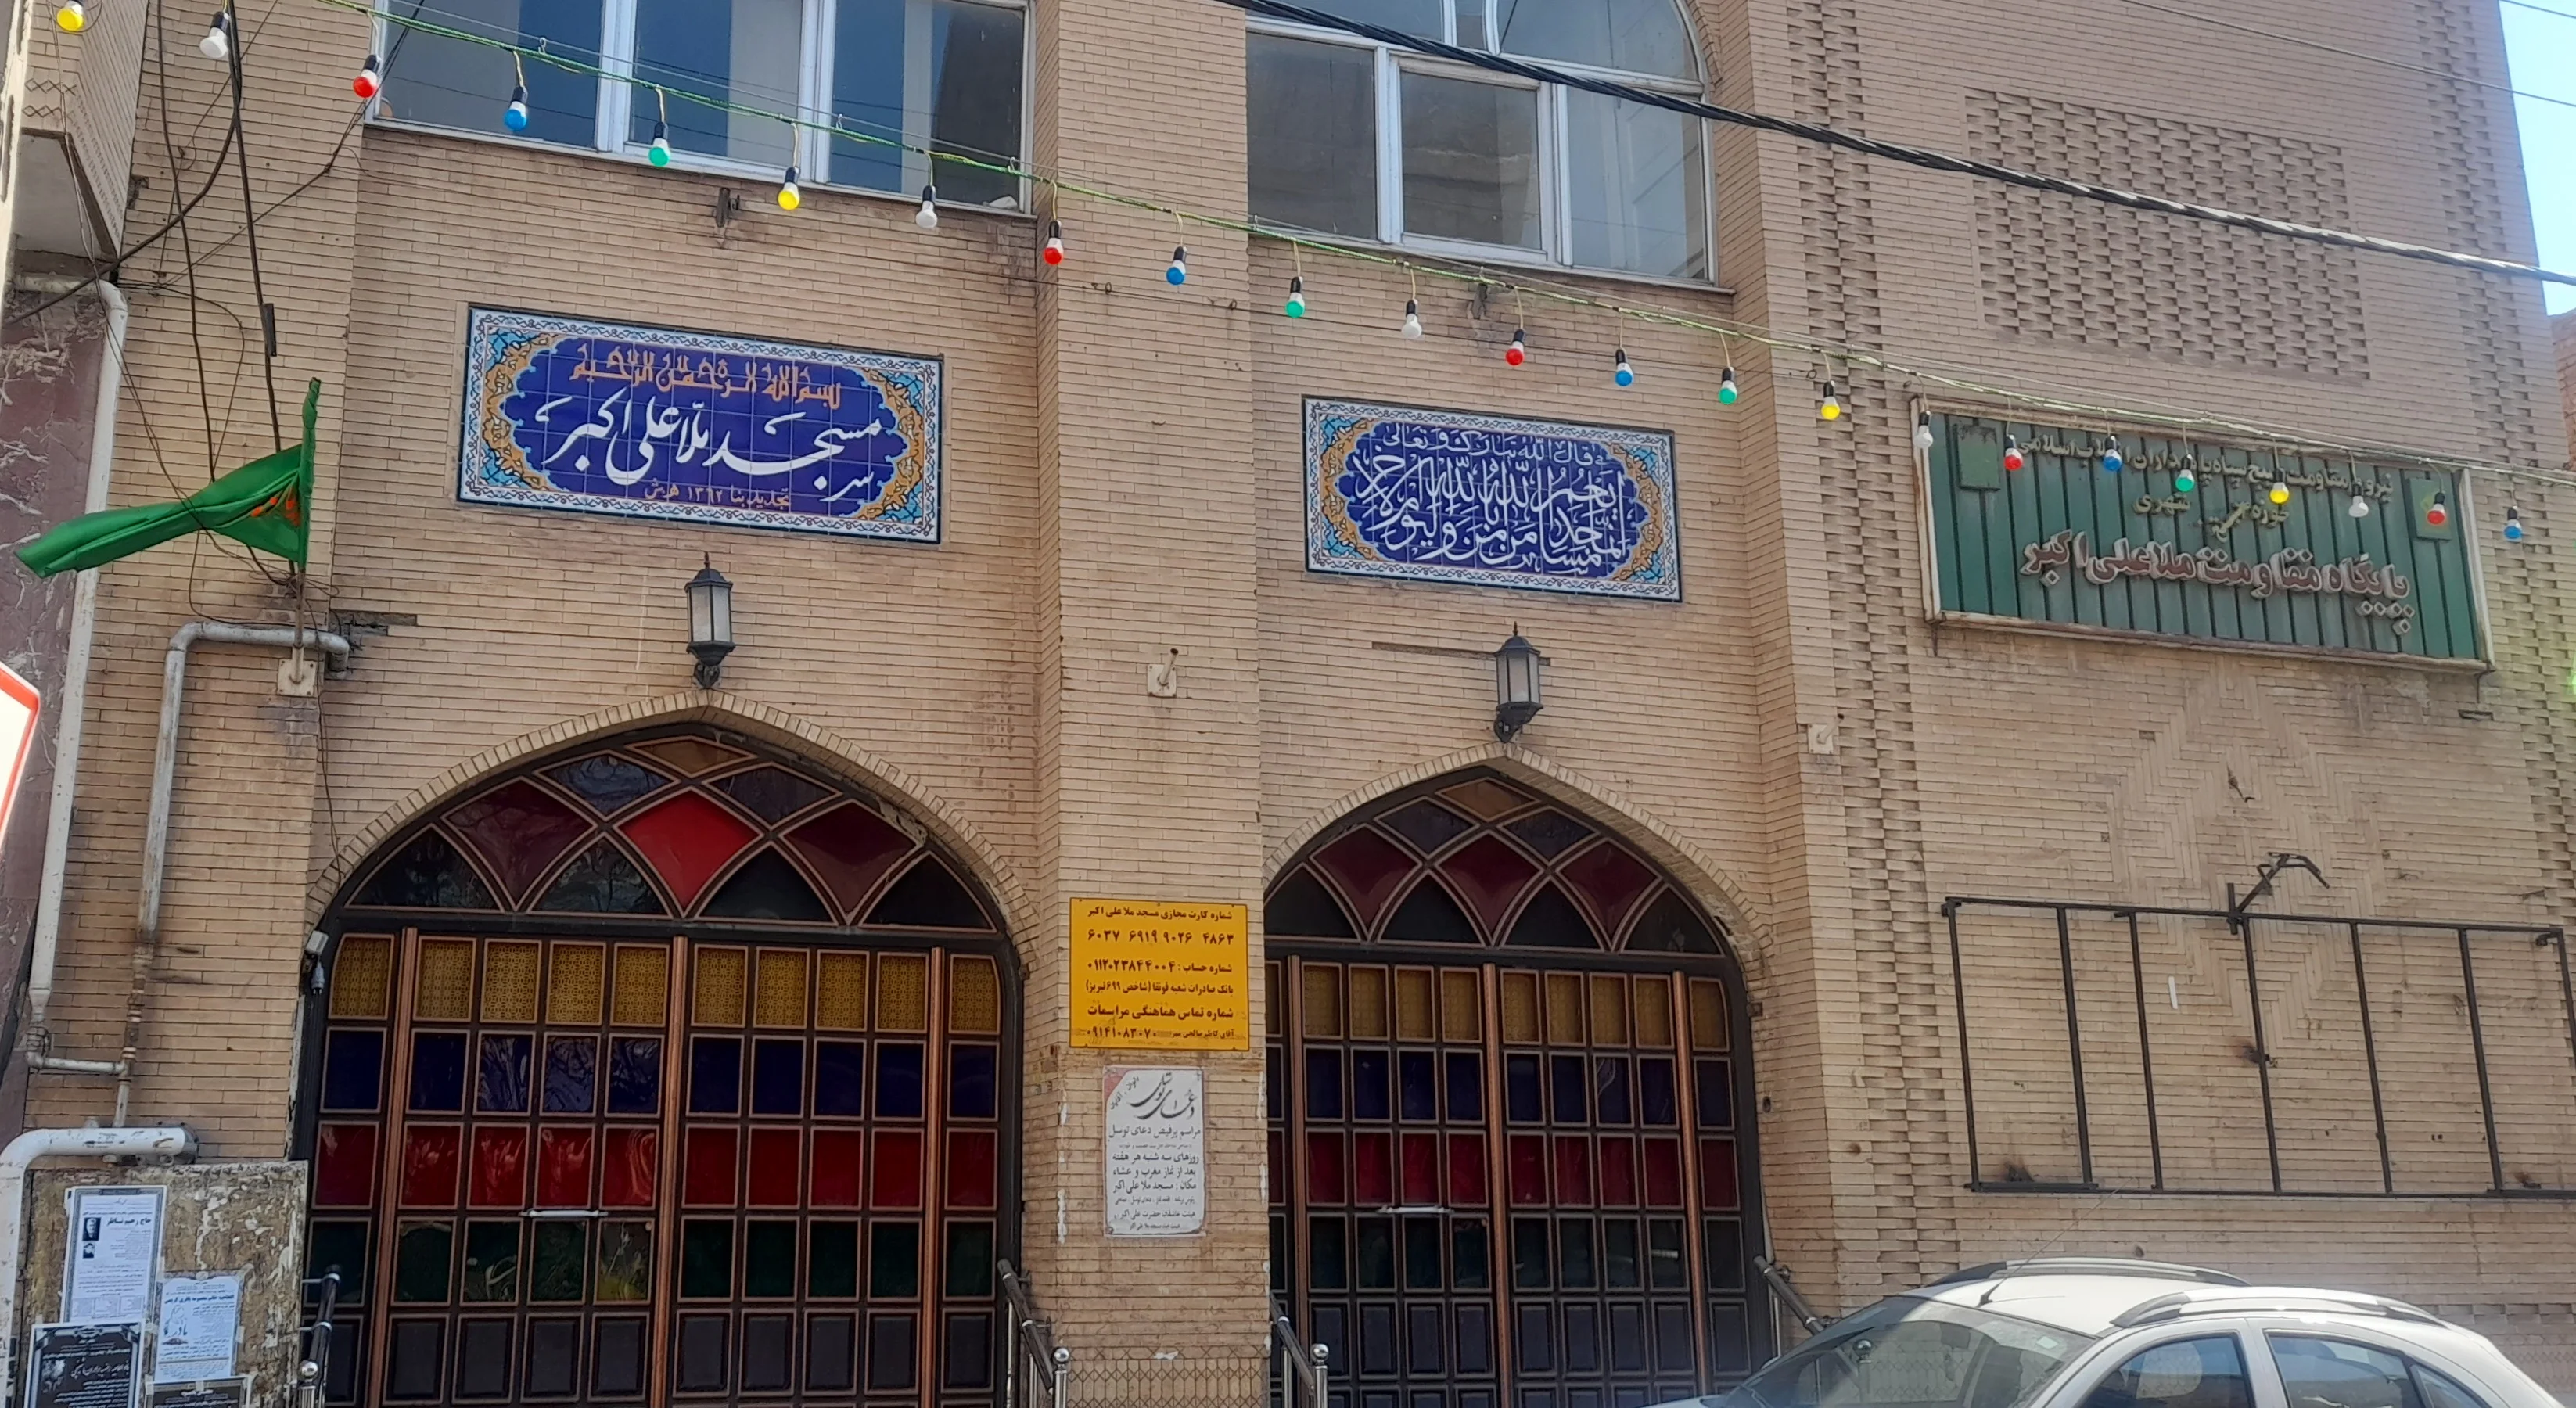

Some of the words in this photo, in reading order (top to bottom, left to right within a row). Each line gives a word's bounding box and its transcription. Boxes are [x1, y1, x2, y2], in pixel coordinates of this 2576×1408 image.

[541, 386, 632, 472] اکبر
[605, 395, 682, 487] علی
[2017, 435, 2075, 457] اسلامی
[702, 417, 883, 490] مسجد
[2019, 528, 2089, 587] اکبر
[2085, 537, 2151, 586] علی
[2148, 540, 2197, 580] ملا
[2196, 546, 2322, 600] مقاومت
[2321, 553, 2415, 636] پایگاه
[1087, 906, 1105, 917] اکبر
[1105, 907, 1122, 918] علی
[1136, 909, 1159, 918] مسجد
[1161, 908, 1187, 921] مجازی
[1188, 910, 1209, 921] کارت
[1209, 911, 1232, 921] شماره
[1087, 928, 1120, 943] ۶۰۳۷
[1129, 928, 1159, 943] ۶۹۱۹
[1163, 931, 1193, 944] ۹۰۲۶
[1202, 932, 1234, 945] ۴۸۶۳
[1209, 963, 1232, 975] شماره
[1170, 982, 1187, 994] شعبه
[1188, 982, 1216, 996] صادرات
[1216, 983, 1234, 997] بانک
[1087, 1004, 1130, 1019] مراسمات
[1131, 1004, 1176, 1020] هماهنگی
[1177, 1006, 1205, 1021] تماس
[1206, 1008, 1234, 1022] شماره
[1108, 1124, 1130, 1140] توسل
[1130, 1126, 1152, 1137] دعای
[1179, 1126, 1202, 1140] مراسم
[1112, 1151, 1130, 1162] هفته
[1142, 1151, 1159, 1163] شنبه
[1141, 1166, 1162, 1179] مغرب
[1176, 1166, 1184, 1179] از
[1184, 1166, 1196, 1177] بعد
[1112, 1179, 1126, 1194] اکبر
[1126, 1180, 1140, 1194] علی
[1140, 1179, 1151, 1191] ملا
[1152, 1181, 1174, 1191] مسجد
